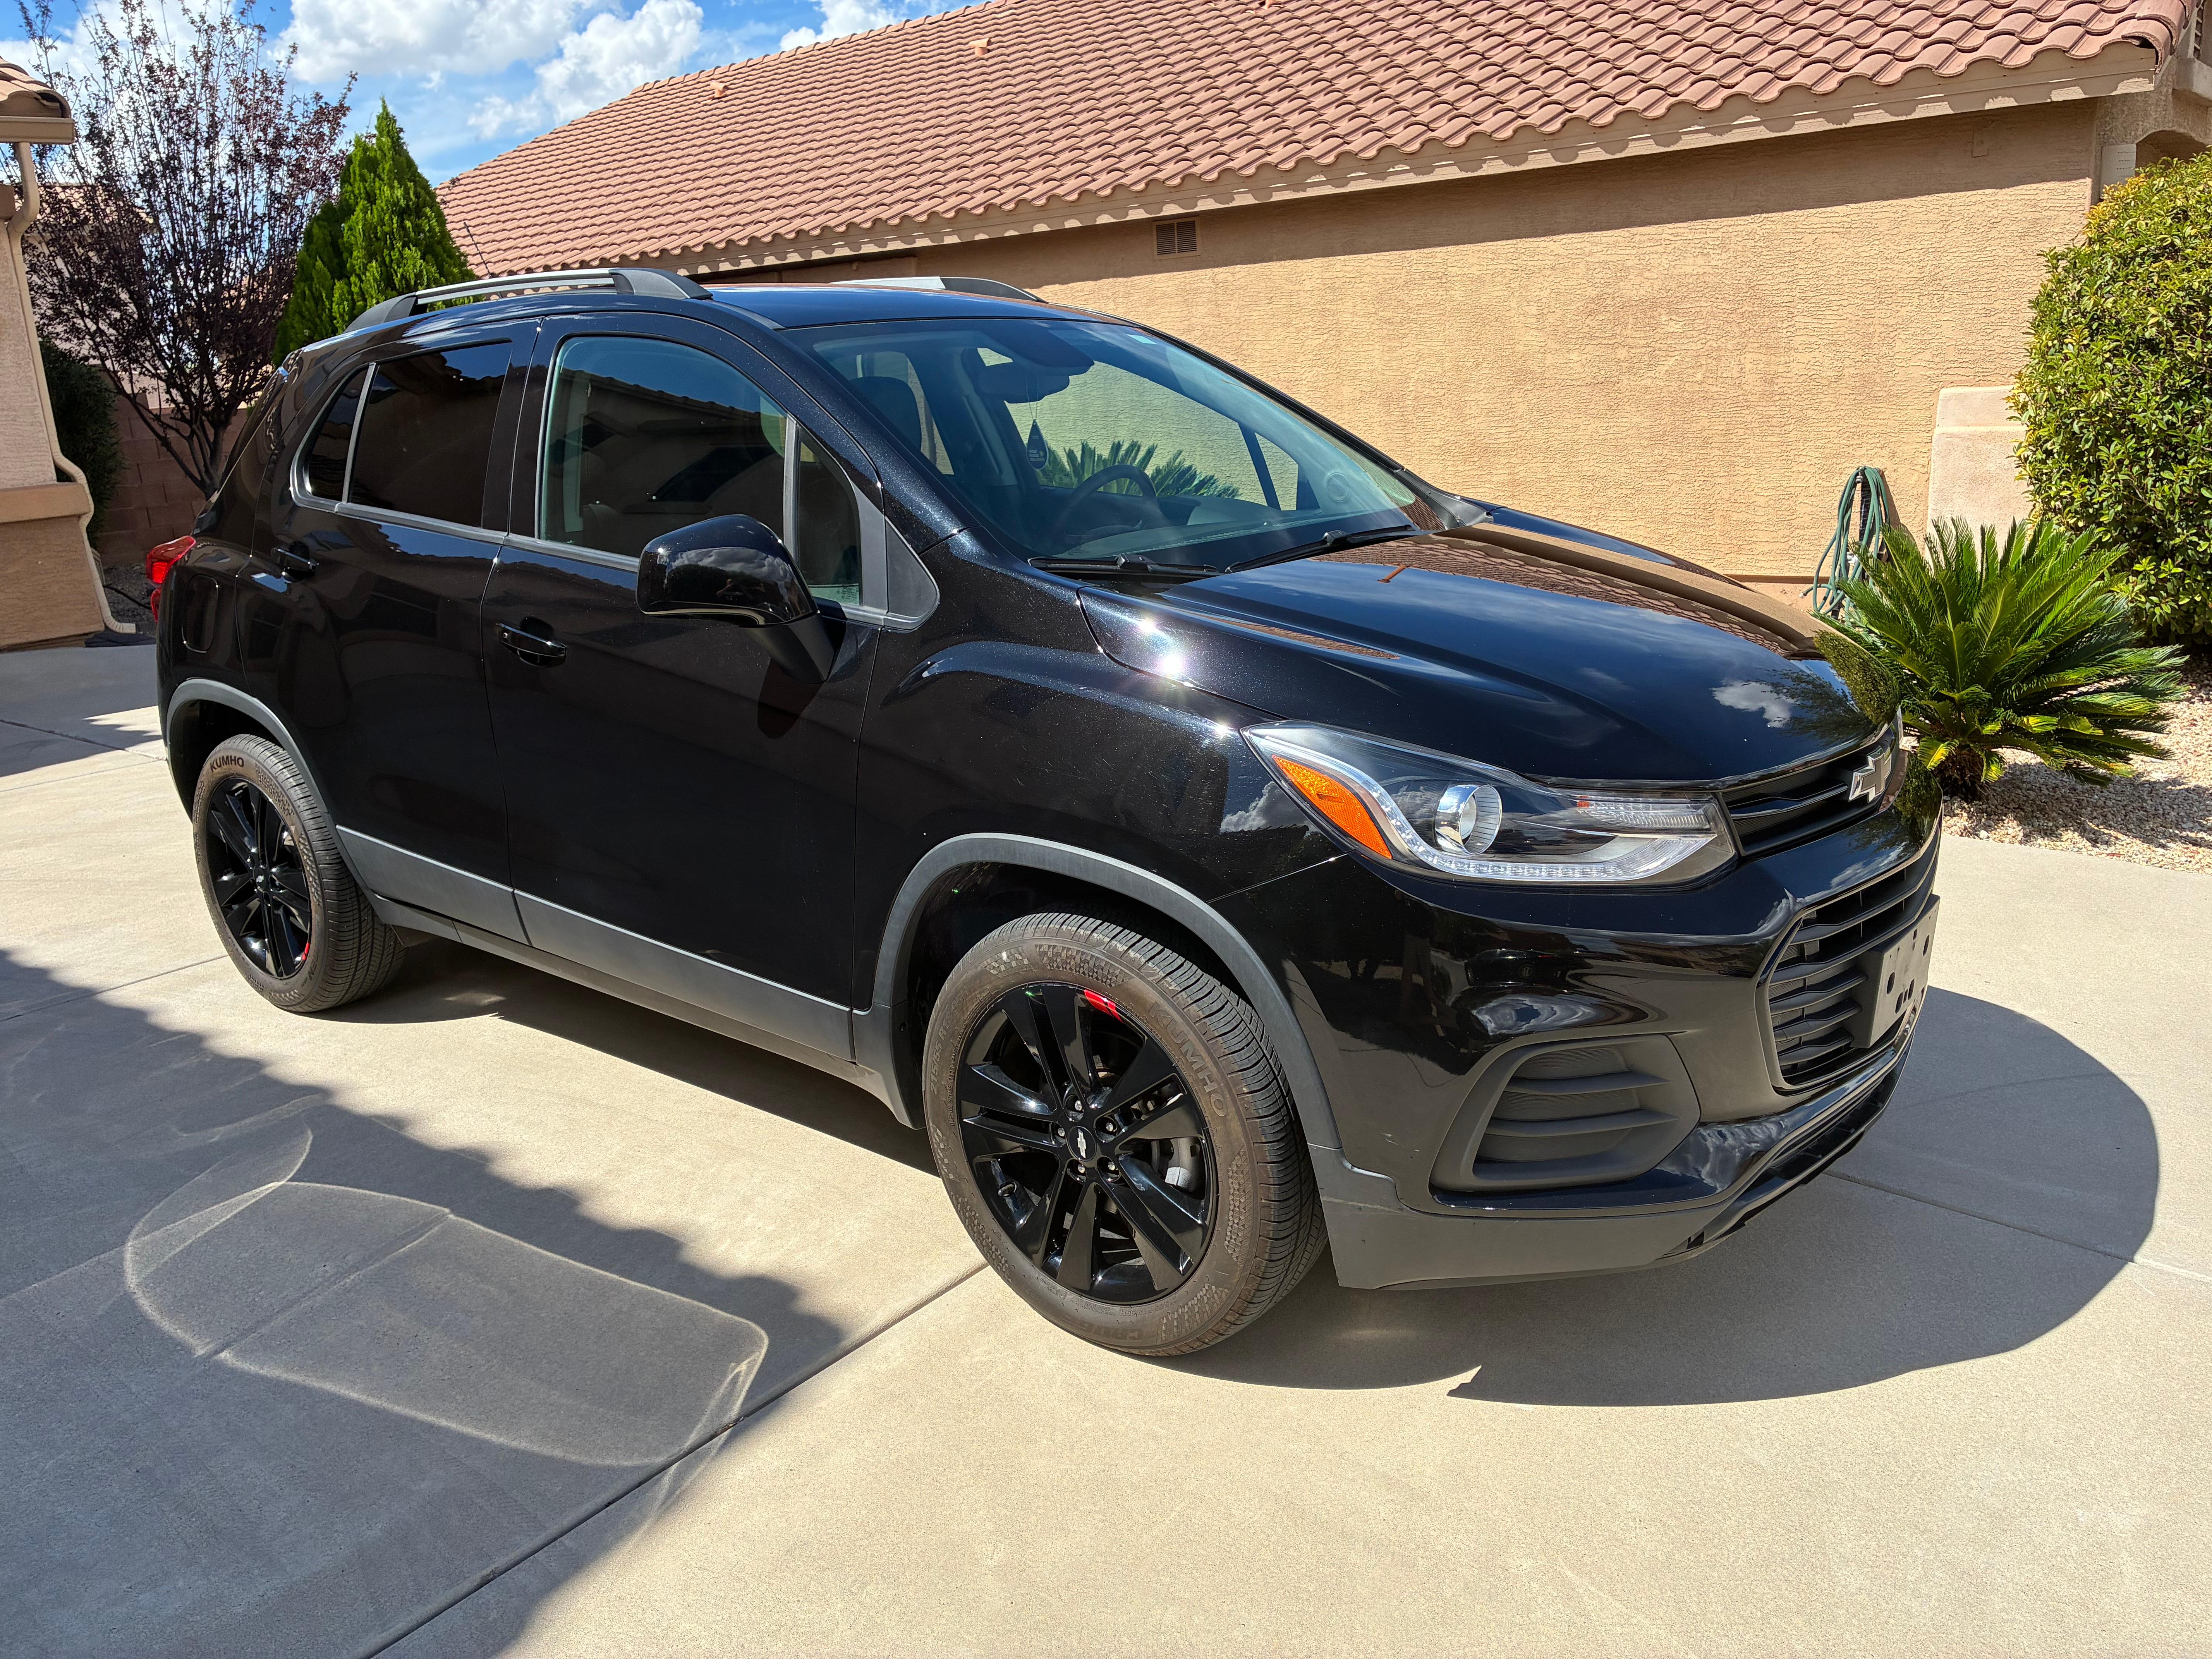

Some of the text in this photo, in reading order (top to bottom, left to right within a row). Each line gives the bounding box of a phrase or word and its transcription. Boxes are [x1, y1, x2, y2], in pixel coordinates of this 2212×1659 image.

[210, 755, 244, 772] KUMHO
[930, 1040, 942, 1095] 215/55
[1149, 1001, 1228, 1117] KUMHO
